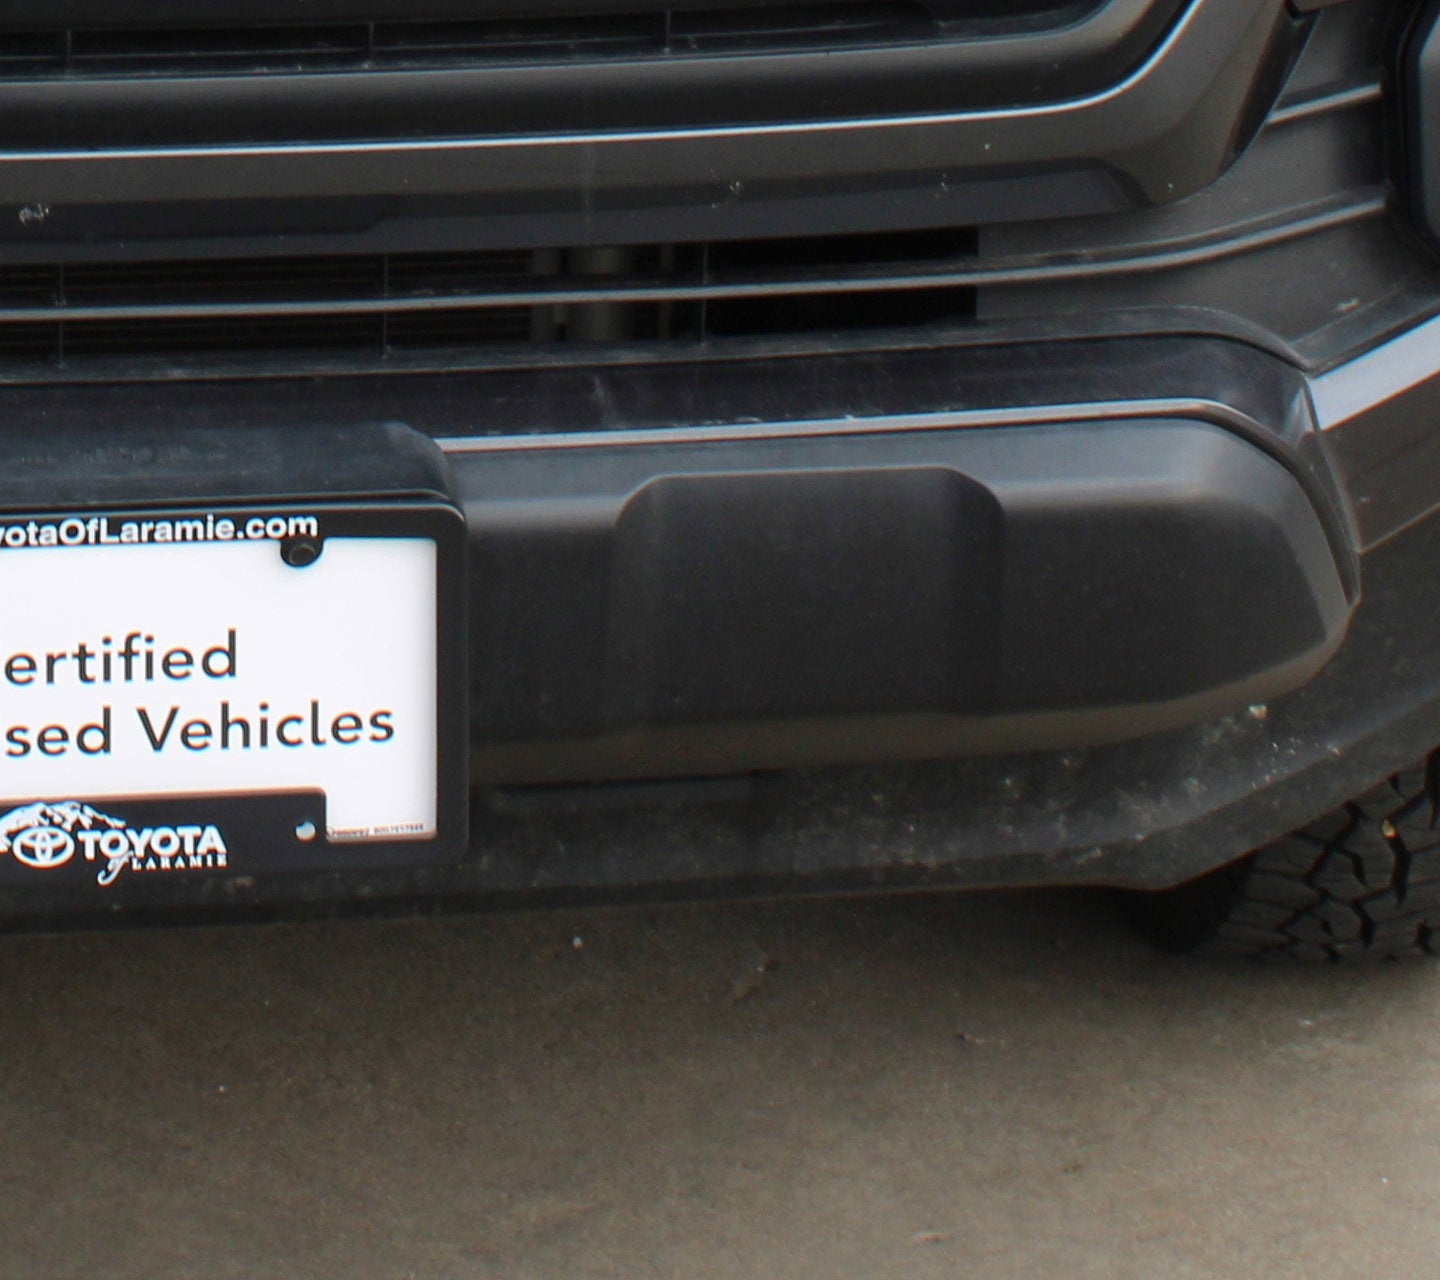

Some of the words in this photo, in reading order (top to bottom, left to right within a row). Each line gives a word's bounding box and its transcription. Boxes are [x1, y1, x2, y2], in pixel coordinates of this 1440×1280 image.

[135, 698, 395, 753] Vehicles
[76, 824, 228, 861] TOYOTA
[131, 852, 228, 872] LARAMIE
